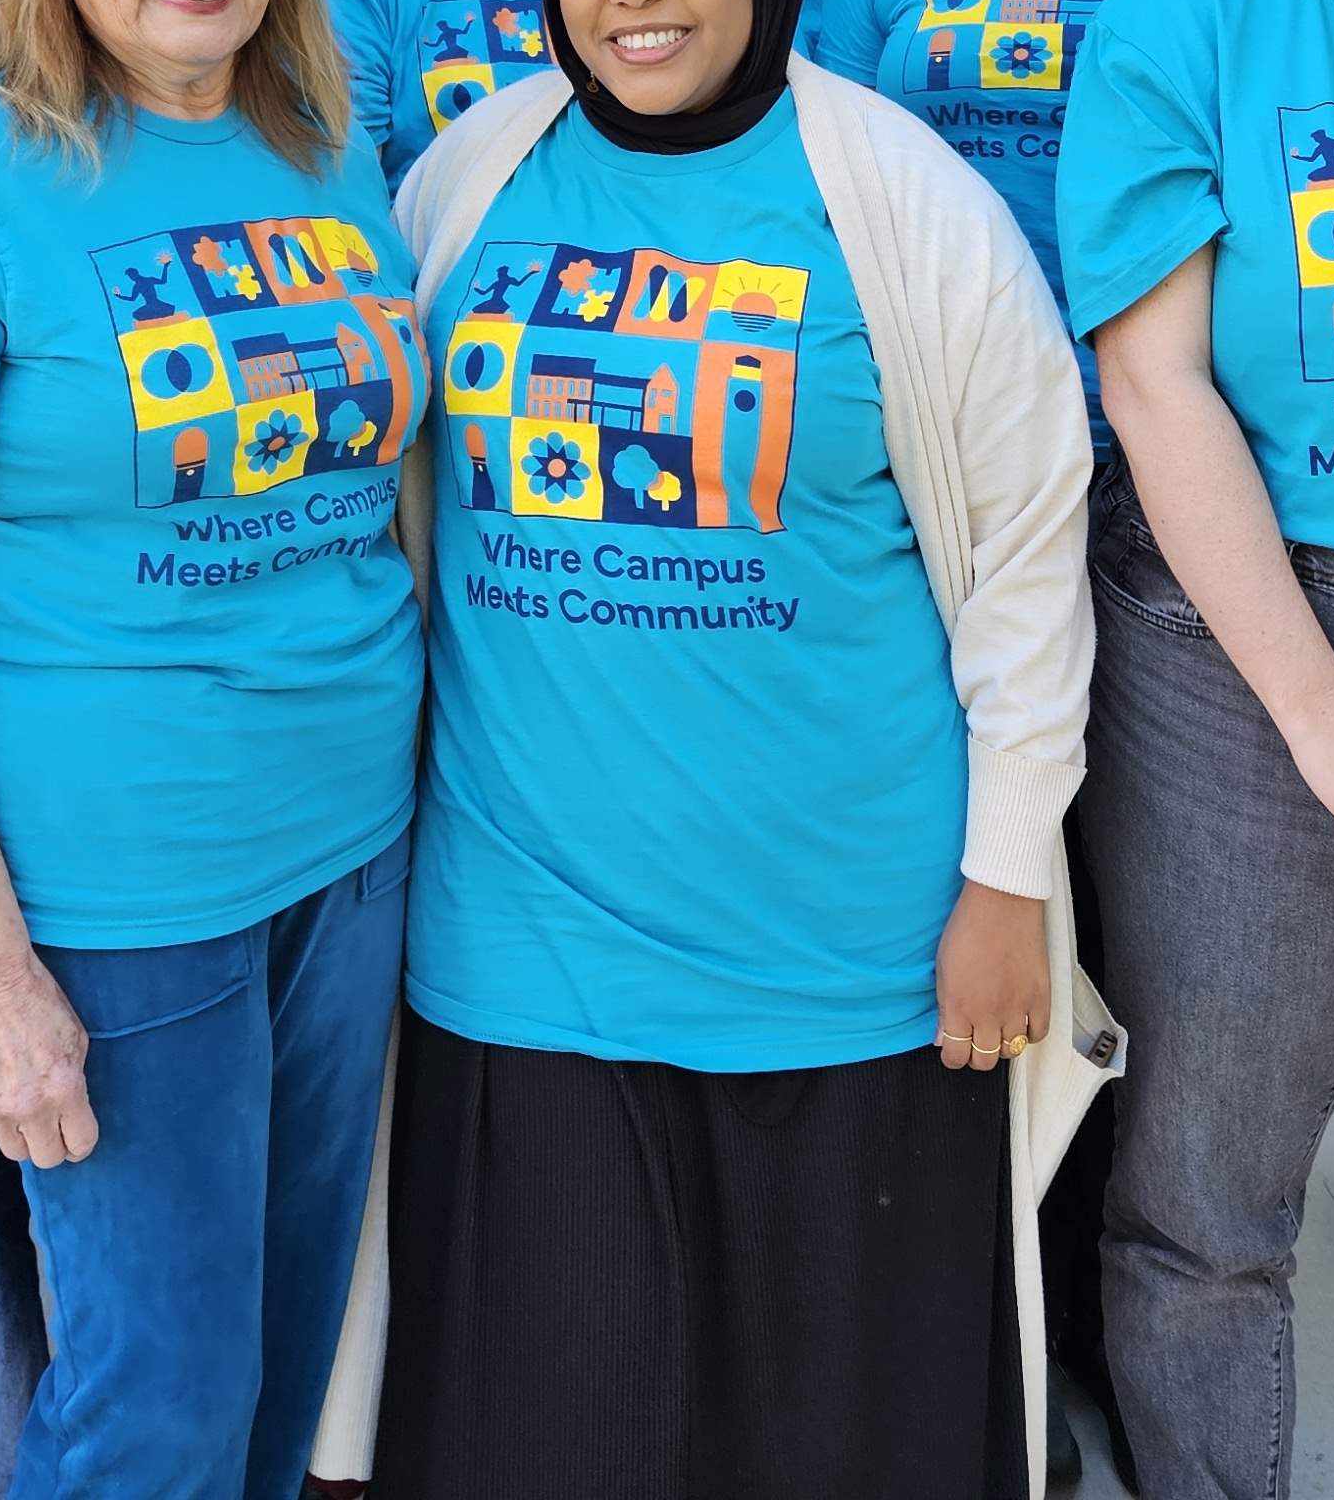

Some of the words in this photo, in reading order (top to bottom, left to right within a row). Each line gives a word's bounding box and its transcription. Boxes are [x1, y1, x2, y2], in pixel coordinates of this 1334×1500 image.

[926, 102, 1038, 127] Where
[946, 136, 1005, 158] ets
[171, 509, 297, 542] Where
[305, 477, 396, 525] Campus
[137, 553, 261, 586] Meets
[478, 530, 581, 574] Where
[593, 544, 765, 591] Campus
[466, 574, 549, 619] Meets
[559, 589, 800, 632] Community
